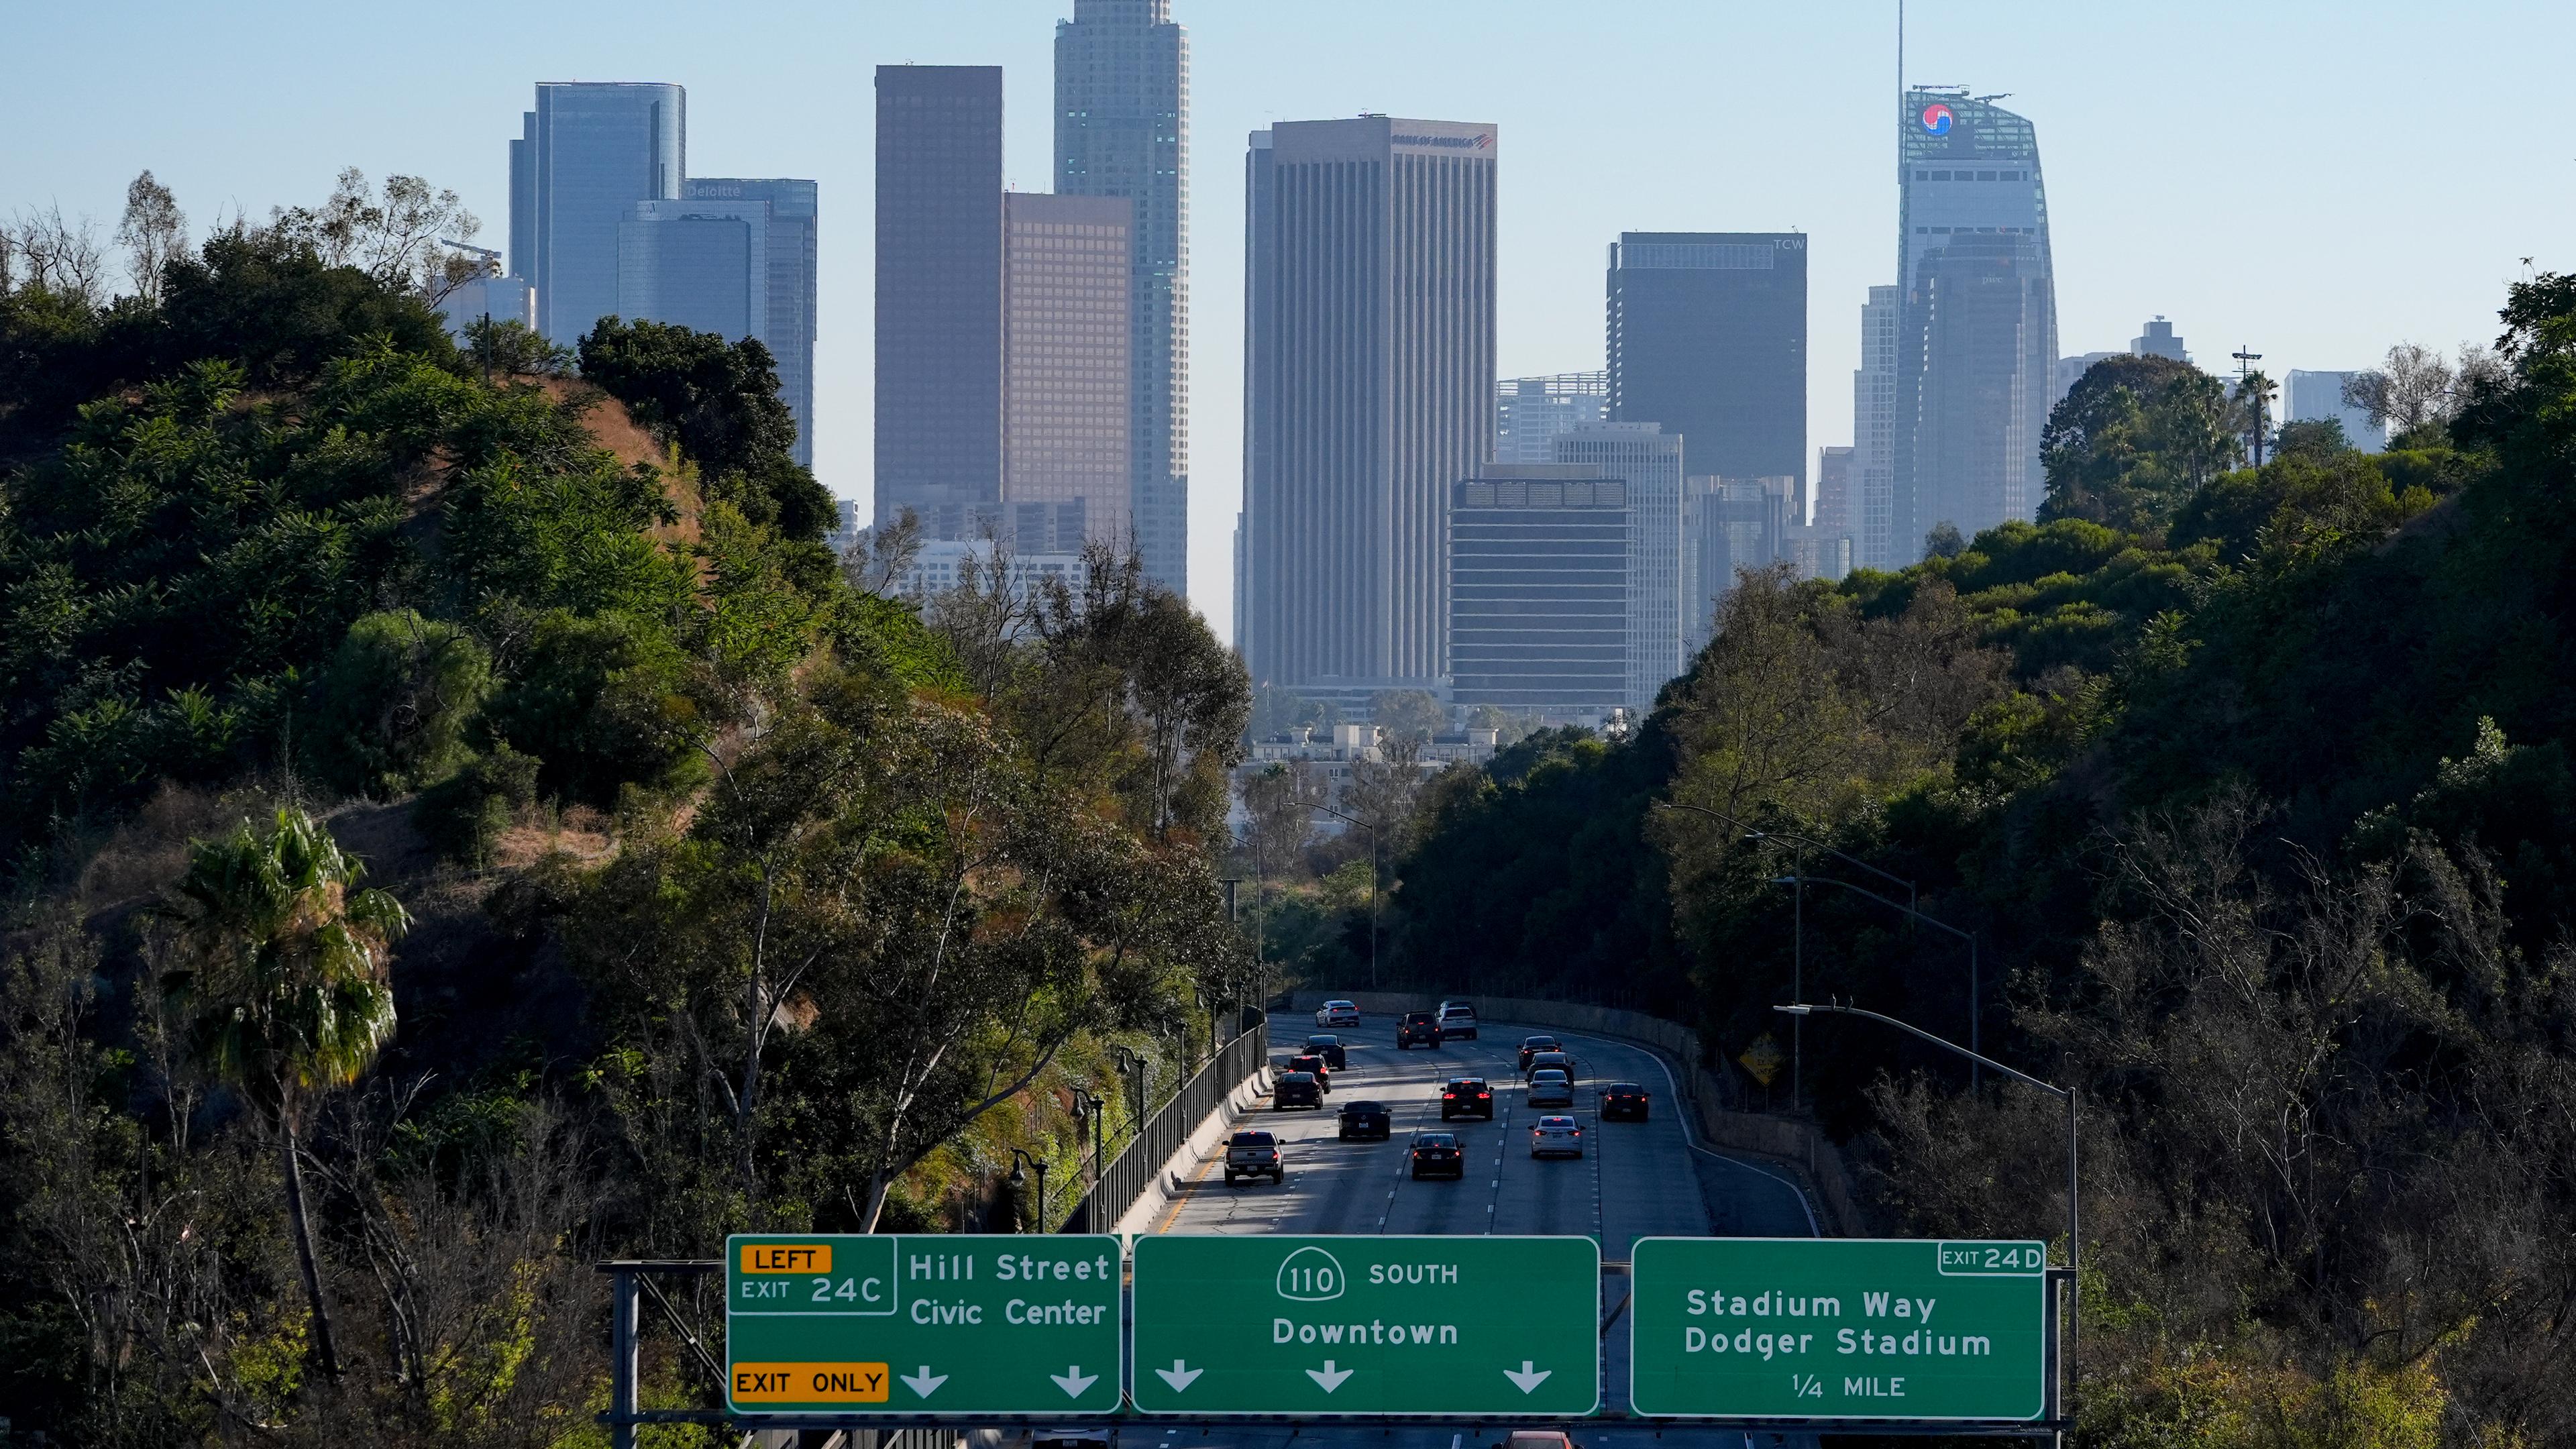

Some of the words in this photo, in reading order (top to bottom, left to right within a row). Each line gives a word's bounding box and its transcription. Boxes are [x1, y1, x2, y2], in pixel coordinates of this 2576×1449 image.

[1430, 137, 1473, 148] AMERICA
[688, 186, 741, 197] Deloitte
[1774, 239, 1805, 250] TCW
[755, 1250, 816, 1269] LEFT
[910, 1254, 973, 1280] Hill
[996, 1254, 1109, 1280] Street
[1943, 1251, 1979, 1265] EXIT
[742, 1281, 790, 1298] EXIT
[812, 1277, 881, 1301] 24C
[1291, 1267, 1334, 1292] 110
[1369, 1264, 1457, 1284] SOUTH
[911, 1299, 982, 1324] Civic
[1006, 1299, 1106, 1324] Center
[1686, 1289, 1840, 1316] Stadium
[1863, 1291, 1936, 1324] Way
[1273, 1318, 1457, 1344] Downtown
[1686, 1327, 1813, 1361] Dodger
[1837, 1328, 1990, 1355] Stadium
[737, 1373, 791, 1393] EXIT
[812, 1373, 883, 1393] ONLY
[1845, 1377, 1905, 1397] MILE
